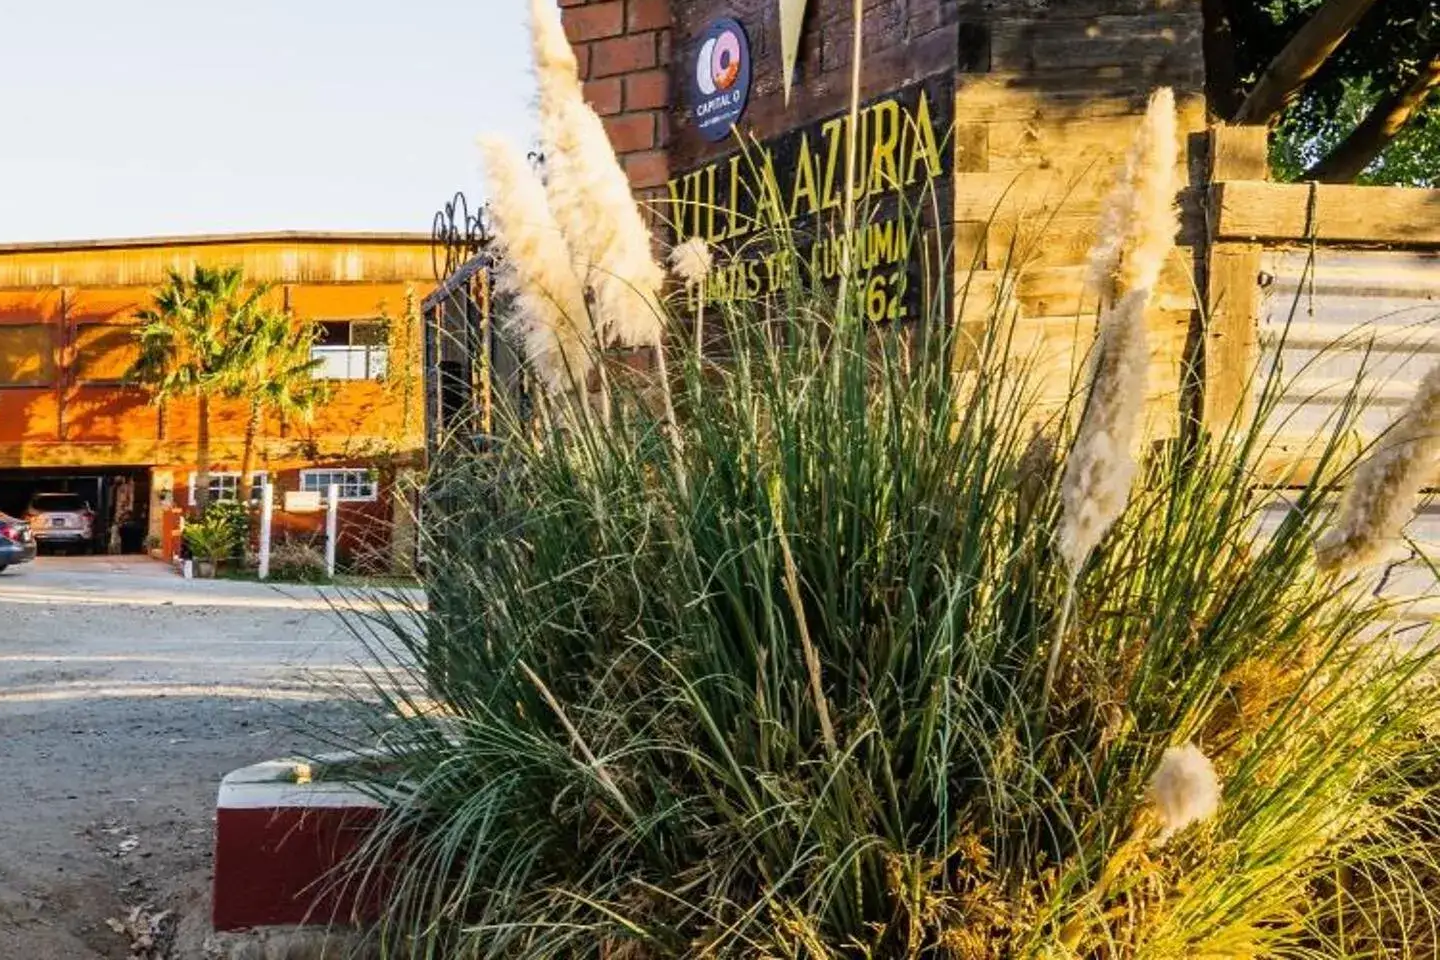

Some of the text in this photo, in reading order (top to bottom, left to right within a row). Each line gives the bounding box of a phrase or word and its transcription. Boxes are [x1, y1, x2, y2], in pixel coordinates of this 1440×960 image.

[696, 93, 732, 116] CAPITAL
[667, 88, 944, 245] VILLA AZURA
